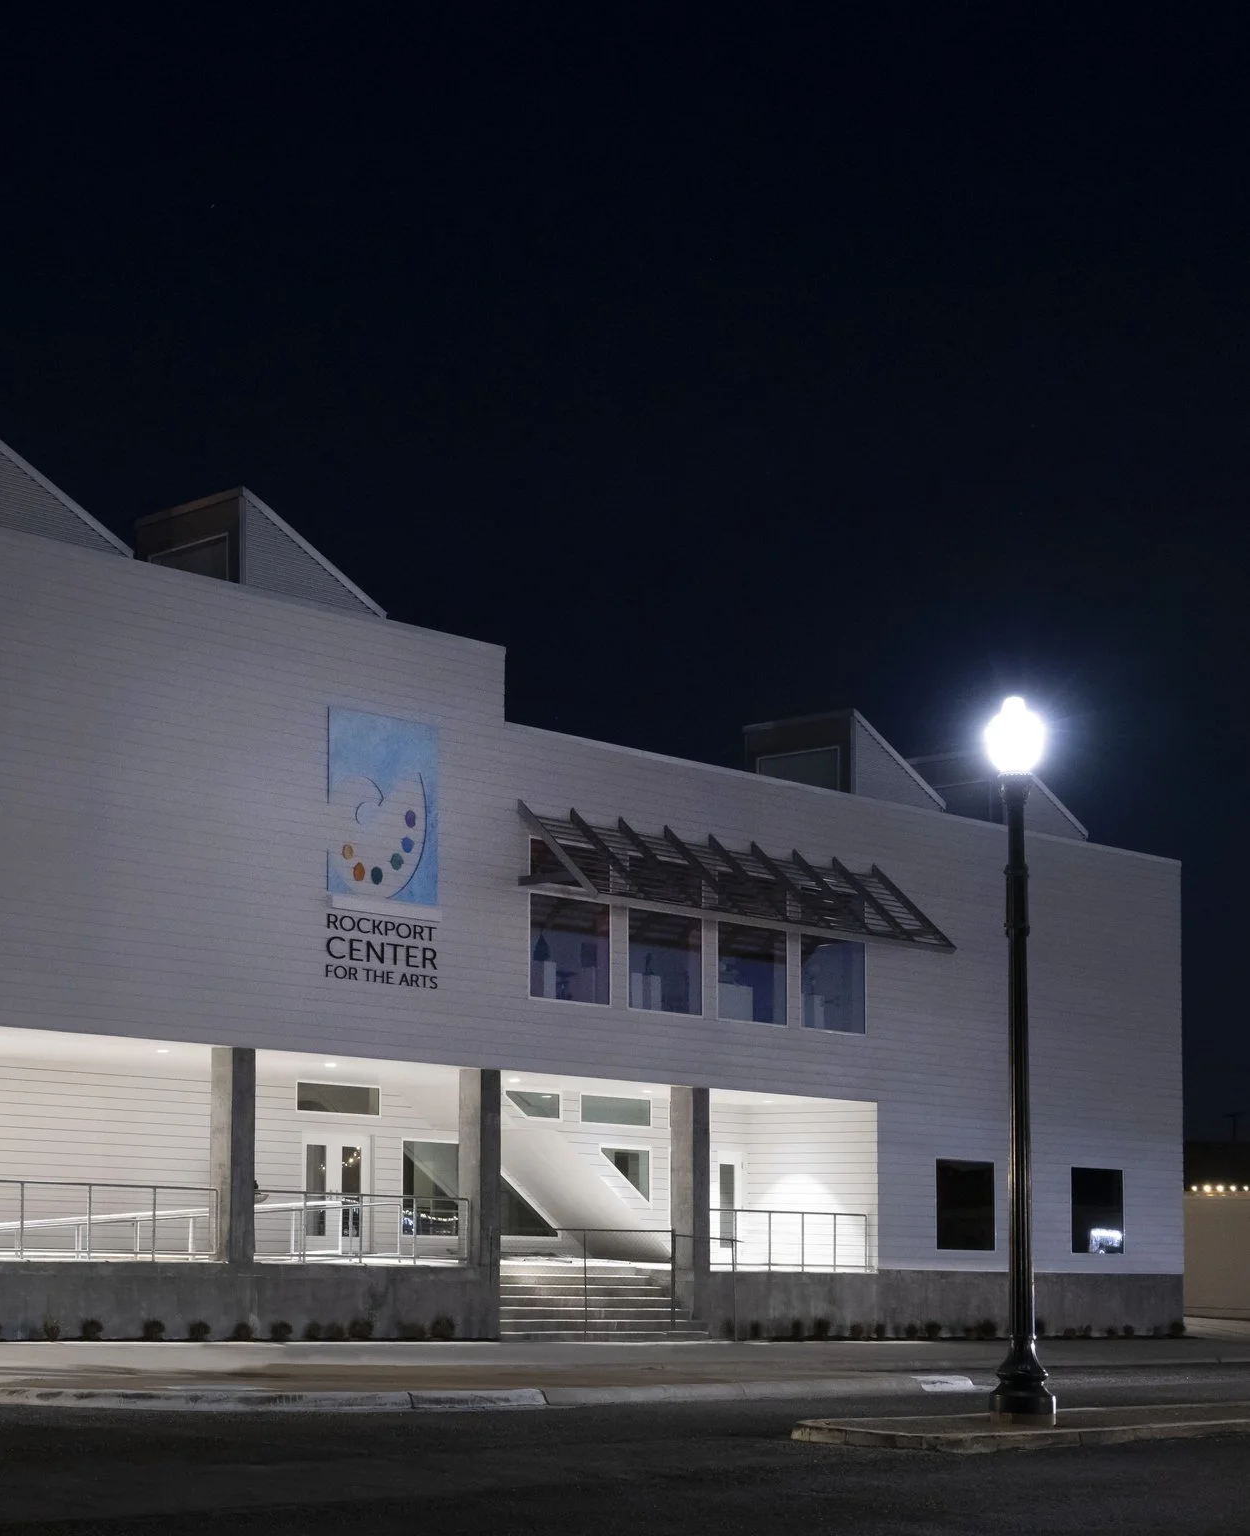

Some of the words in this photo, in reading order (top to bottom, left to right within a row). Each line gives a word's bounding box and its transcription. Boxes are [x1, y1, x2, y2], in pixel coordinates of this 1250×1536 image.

[326, 913, 438, 942] ROCKPORT
[325, 936, 438, 970] CENTER
[325, 964, 358, 981] FOR
[362, 968, 395, 985] THE
[398, 973, 438, 990] ARTS
